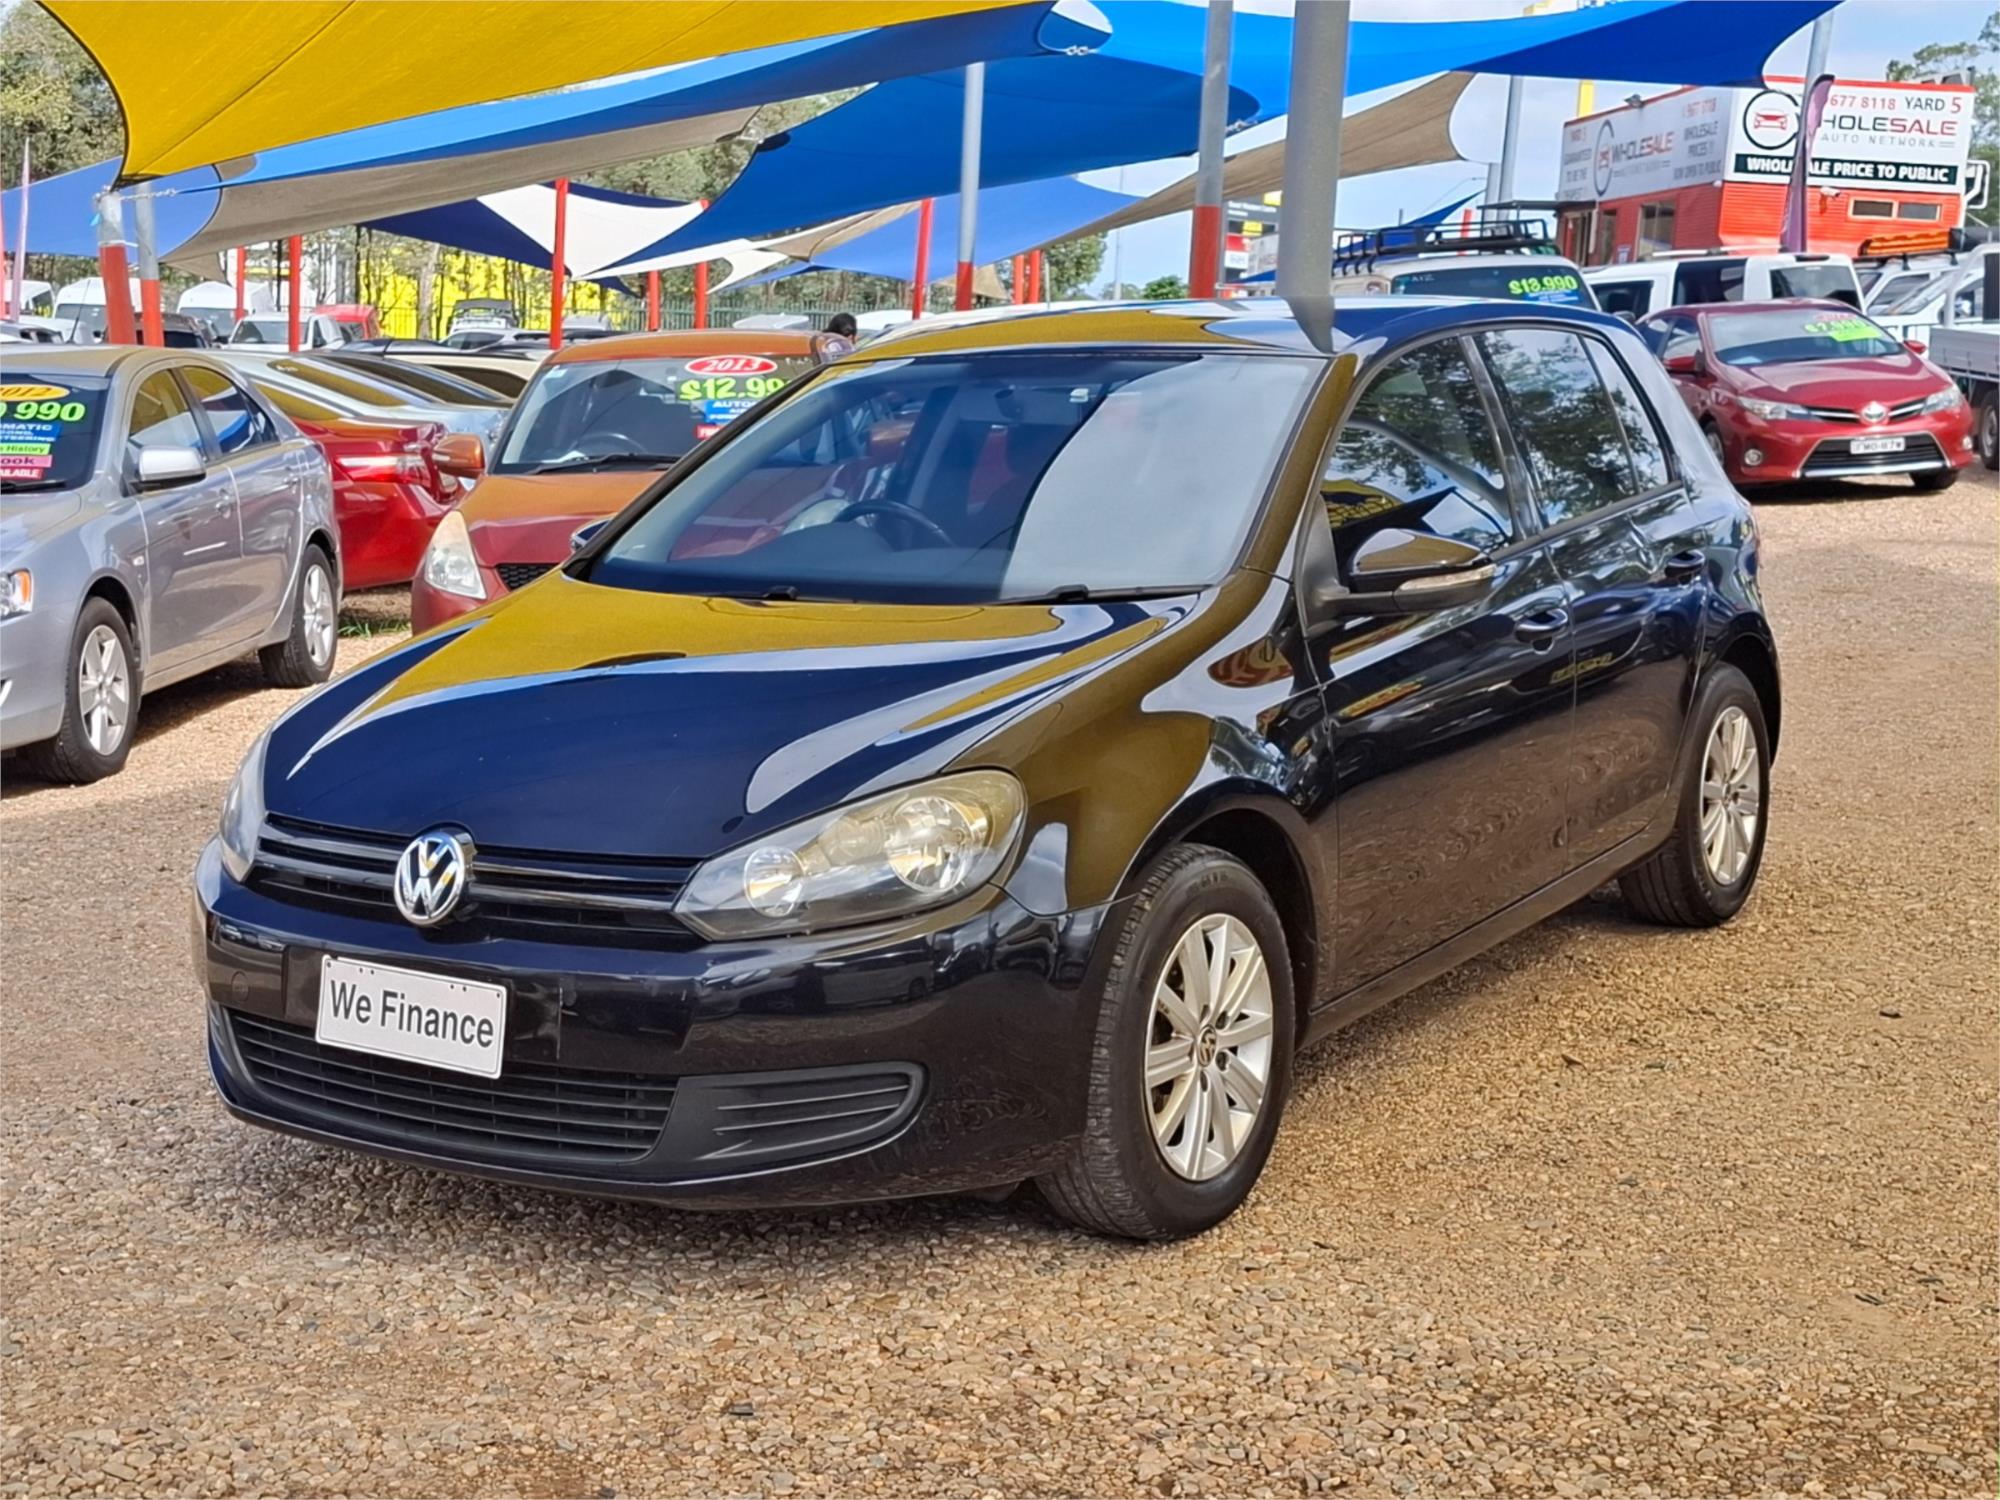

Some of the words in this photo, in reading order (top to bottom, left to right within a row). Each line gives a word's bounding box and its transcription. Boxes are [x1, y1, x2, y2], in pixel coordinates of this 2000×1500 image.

[1861, 95, 1896, 110] 8118
[1905, 96, 1945, 112] YARD
[1951, 97, 1962, 114] 5
[1823, 114, 1958, 136] HOLESALE
[1612, 131, 1675, 163] WHOLESALE
[1821, 132, 1859, 144] AUTO
[1868, 135, 1936, 148] NETWORK
[1747, 157, 1830, 175] WHOLALE
[1833, 161, 1874, 178] PRICE
[1878, 164, 1898, 179] TO
[1899, 165, 1950, 182] PUBLIC
[703, 358, 763, 371] 2013
[679, 377, 787, 400] $12.99
[14, 401, 86, 422] 990
[0, 423, 53, 431] MATIC
[6, 445, 46, 454] History
[1, 457, 35, 465] ook
[331, 979, 372, 1024] We
[380, 989, 494, 1048] Finance
